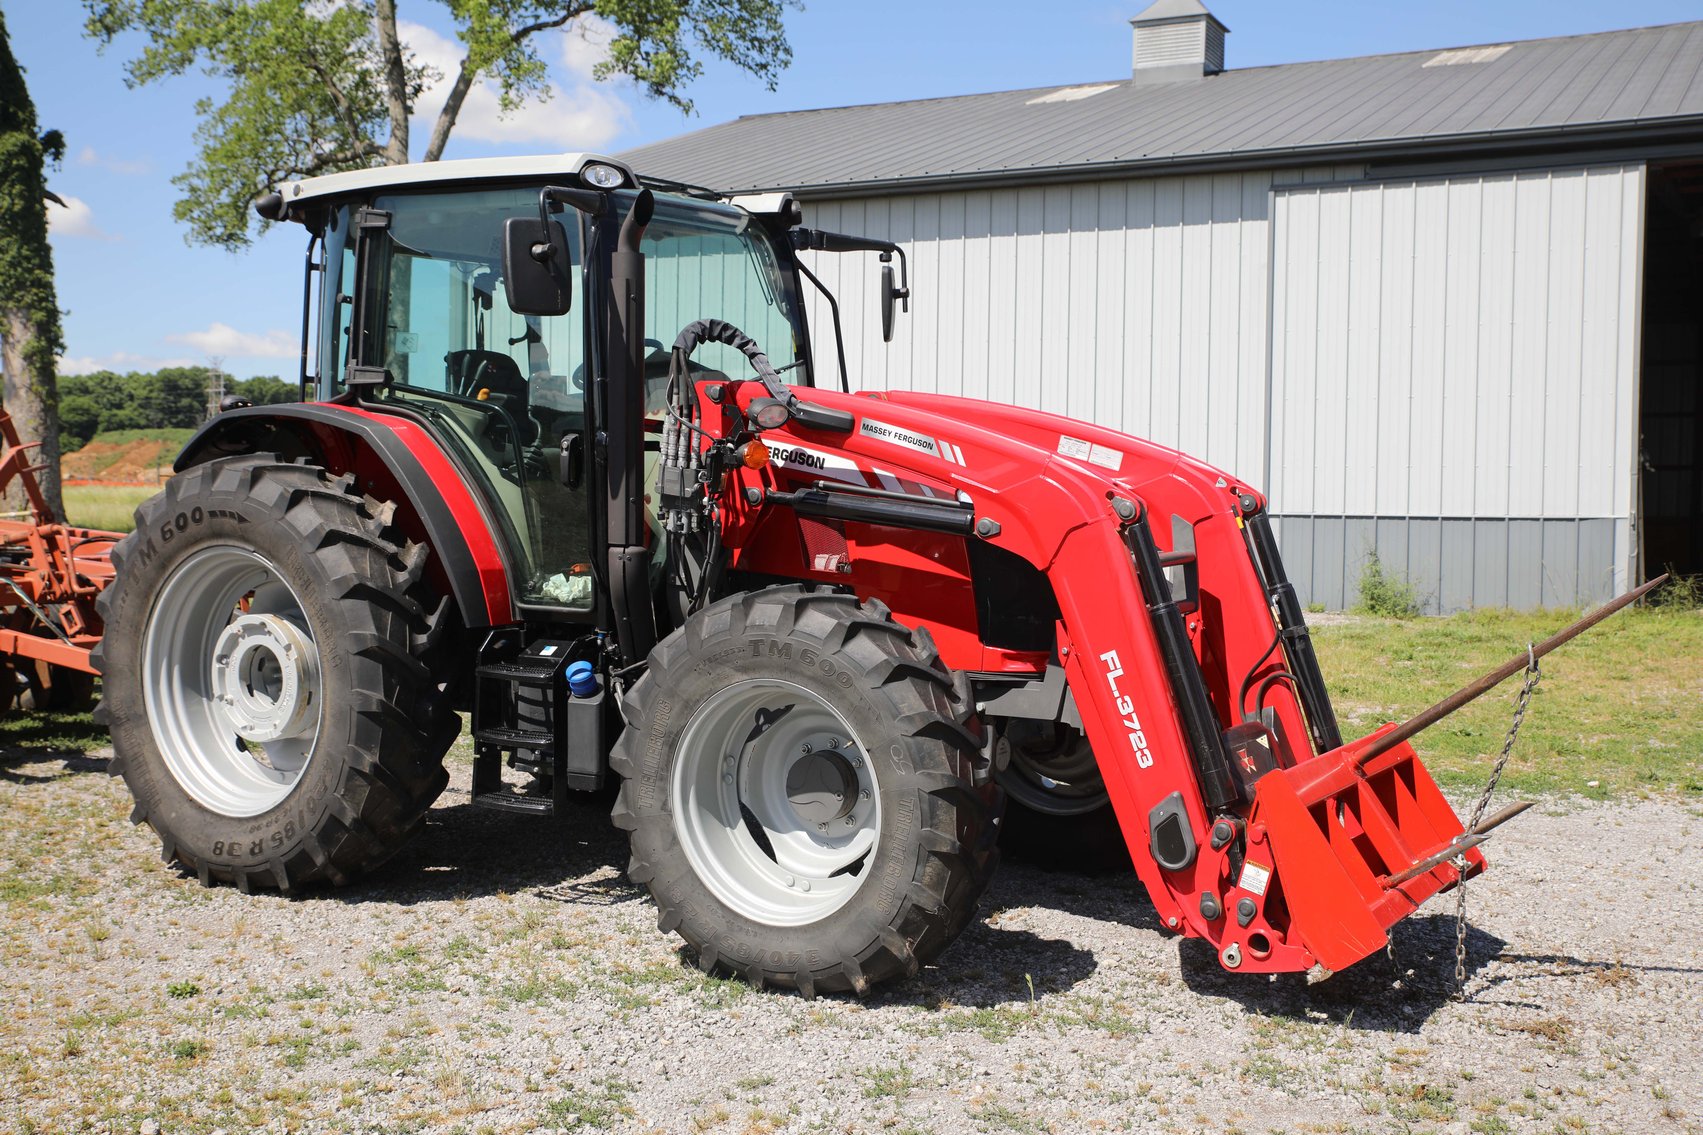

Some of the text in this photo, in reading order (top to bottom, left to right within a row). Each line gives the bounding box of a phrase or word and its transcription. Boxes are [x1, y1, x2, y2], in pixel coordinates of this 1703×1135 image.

[862, 423, 934, 450] MASSEY FERGUSON
[768, 446, 826, 470] ERGUSON
[160, 506, 204, 544] 600
[748, 639, 793, 660] TM
[800, 648, 854, 689] 600
[637, 698, 672, 809] TRELLEBORG
[212, 840, 242, 857] 38
[249, 839, 264, 856] R
[877, 797, 915, 915] TRELLEBORG
[671, 886, 699, 920] 28
[698, 921, 719, 941] R
[719, 934, 822, 966] 340/85
